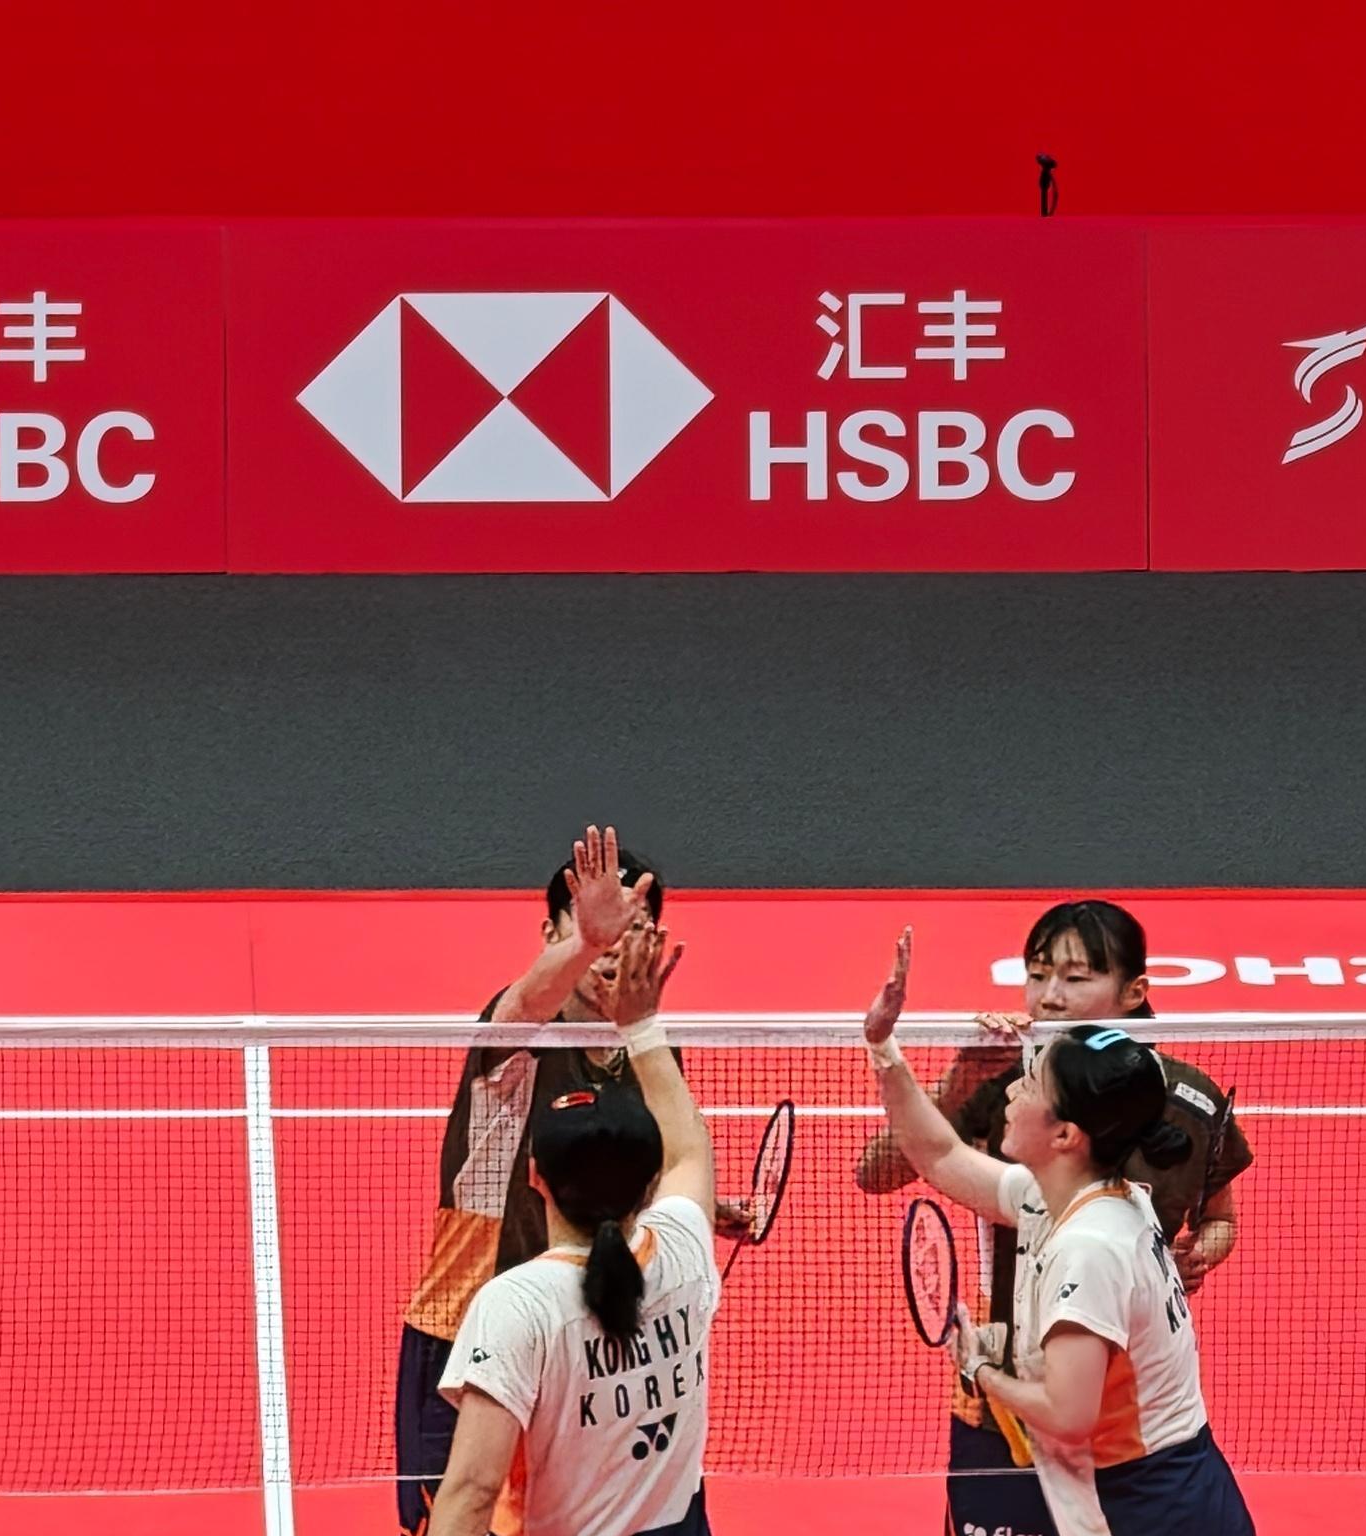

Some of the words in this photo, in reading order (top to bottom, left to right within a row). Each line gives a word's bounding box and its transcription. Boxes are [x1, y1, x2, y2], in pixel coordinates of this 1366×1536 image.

[816, 290, 1006, 381] 汇丰
[749, 409, 1076, 502] HSBC
[584, 1326, 652, 1380] KONG
[653, 1304, 690, 1359] HY
